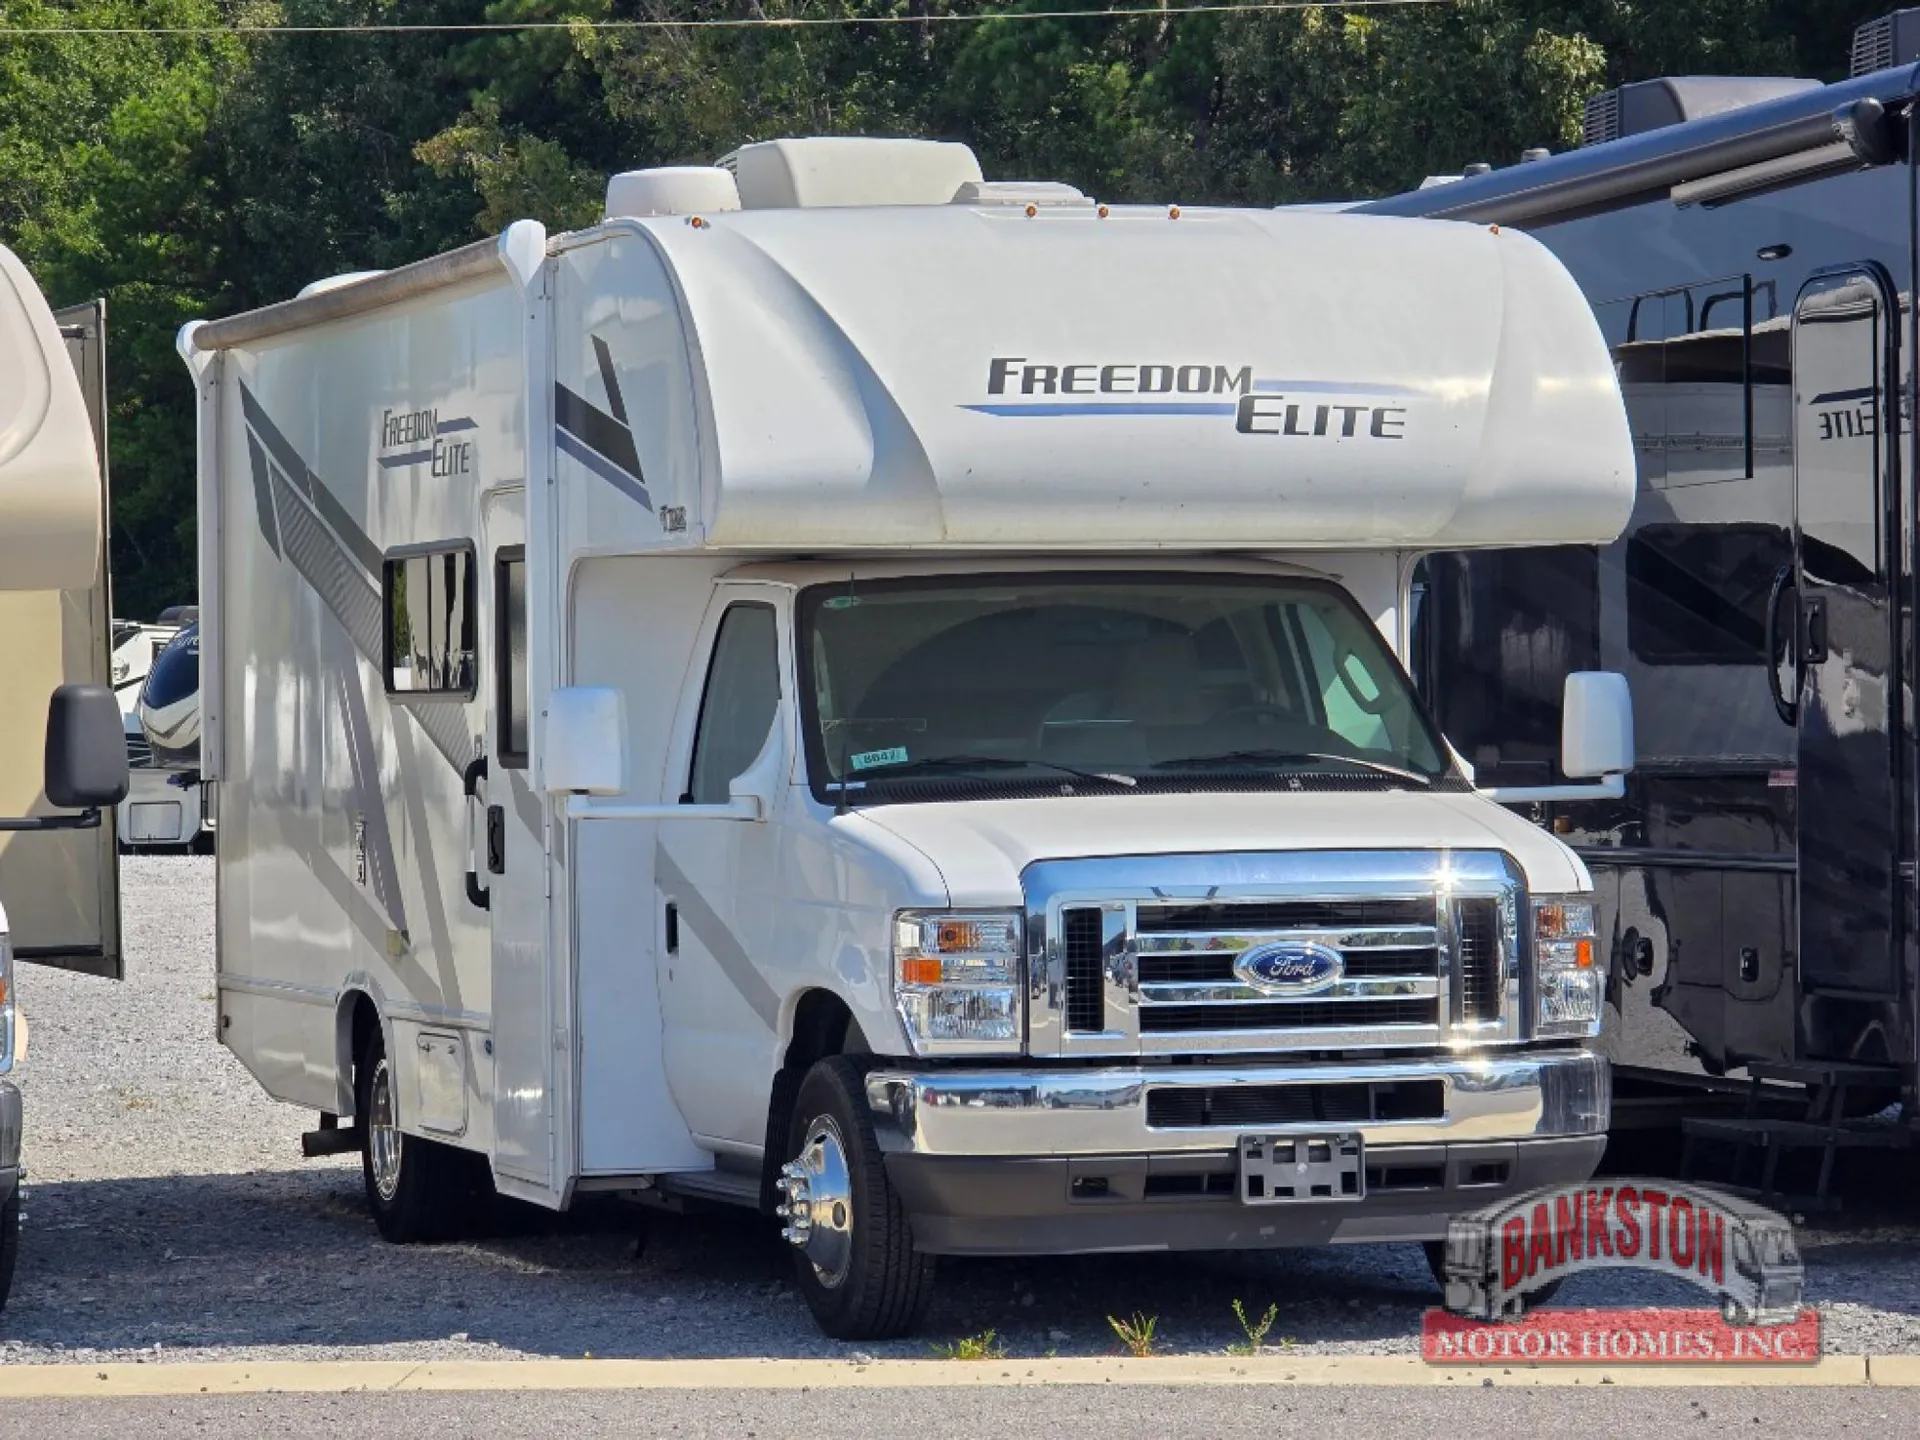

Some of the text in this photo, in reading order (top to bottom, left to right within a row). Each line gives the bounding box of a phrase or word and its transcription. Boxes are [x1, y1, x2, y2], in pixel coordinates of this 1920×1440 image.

[988, 357, 1253, 395] FREEDOM
[382, 408, 438, 449] FREEDOM
[1235, 395, 1407, 439] ELITE
[432, 438, 471, 478] ELITE
[1269, 955, 1317, 976] Ford
